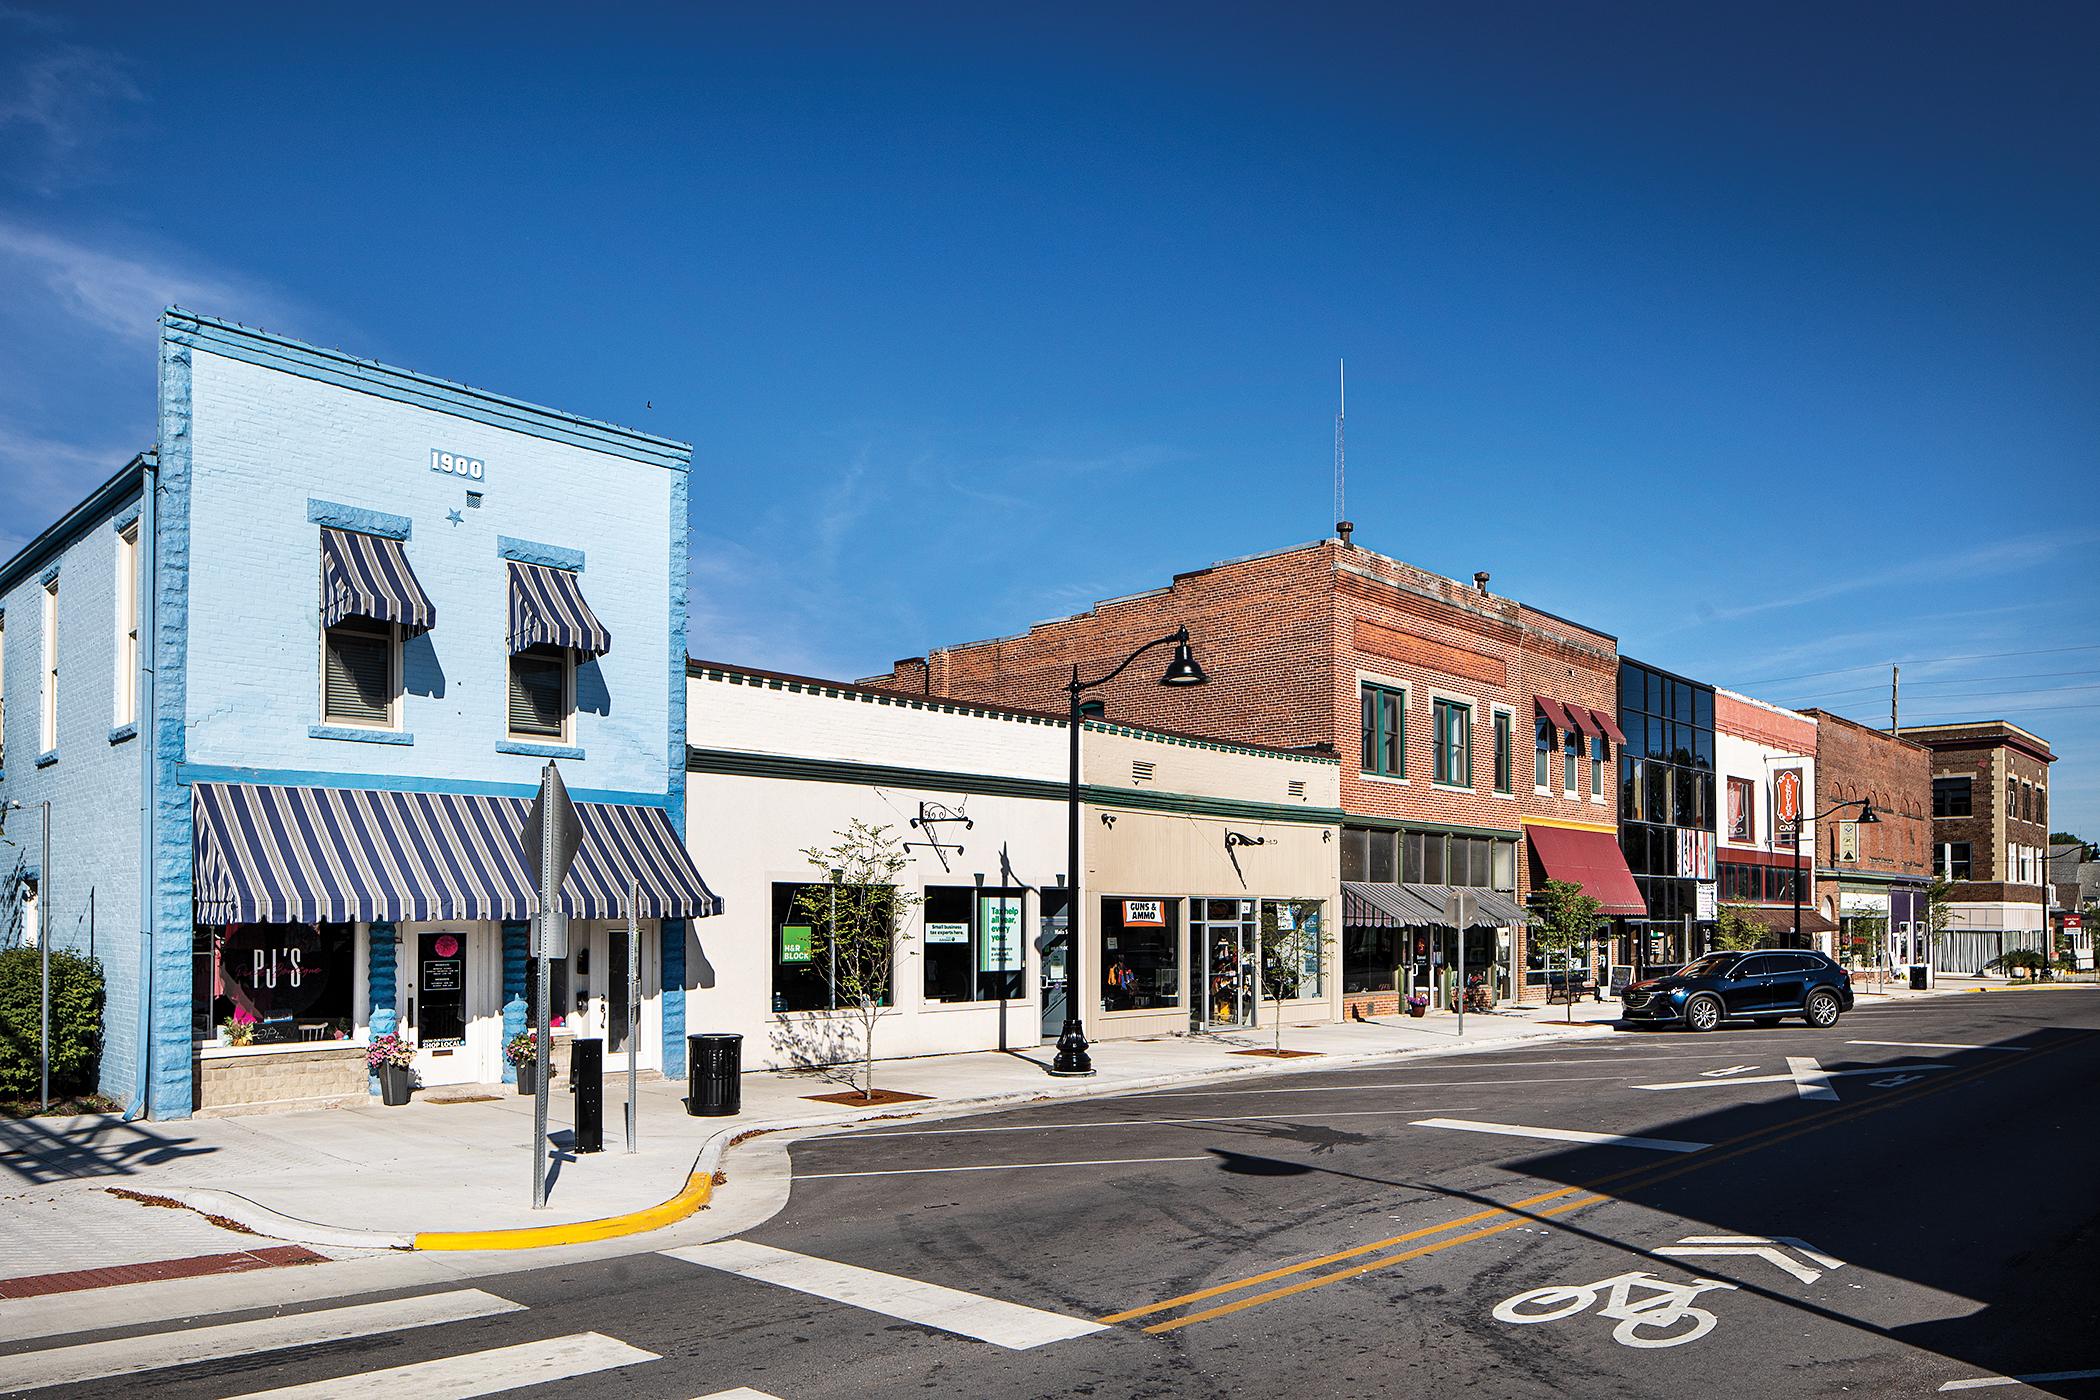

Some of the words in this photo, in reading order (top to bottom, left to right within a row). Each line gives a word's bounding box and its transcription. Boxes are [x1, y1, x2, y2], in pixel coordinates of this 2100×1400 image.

[431, 451, 483, 479] 1900
[991, 907, 1004, 915] Tax
[1004, 907, 1018, 916] help
[1130, 903, 1149, 911] GUNS
[1151, 903, 1157, 911] &
[991, 916, 1000, 924] all
[253, 947, 301, 989] PJ'S
[422, 1041, 441, 1049] SHOP
[441, 1039, 461, 1048] LOCAL
